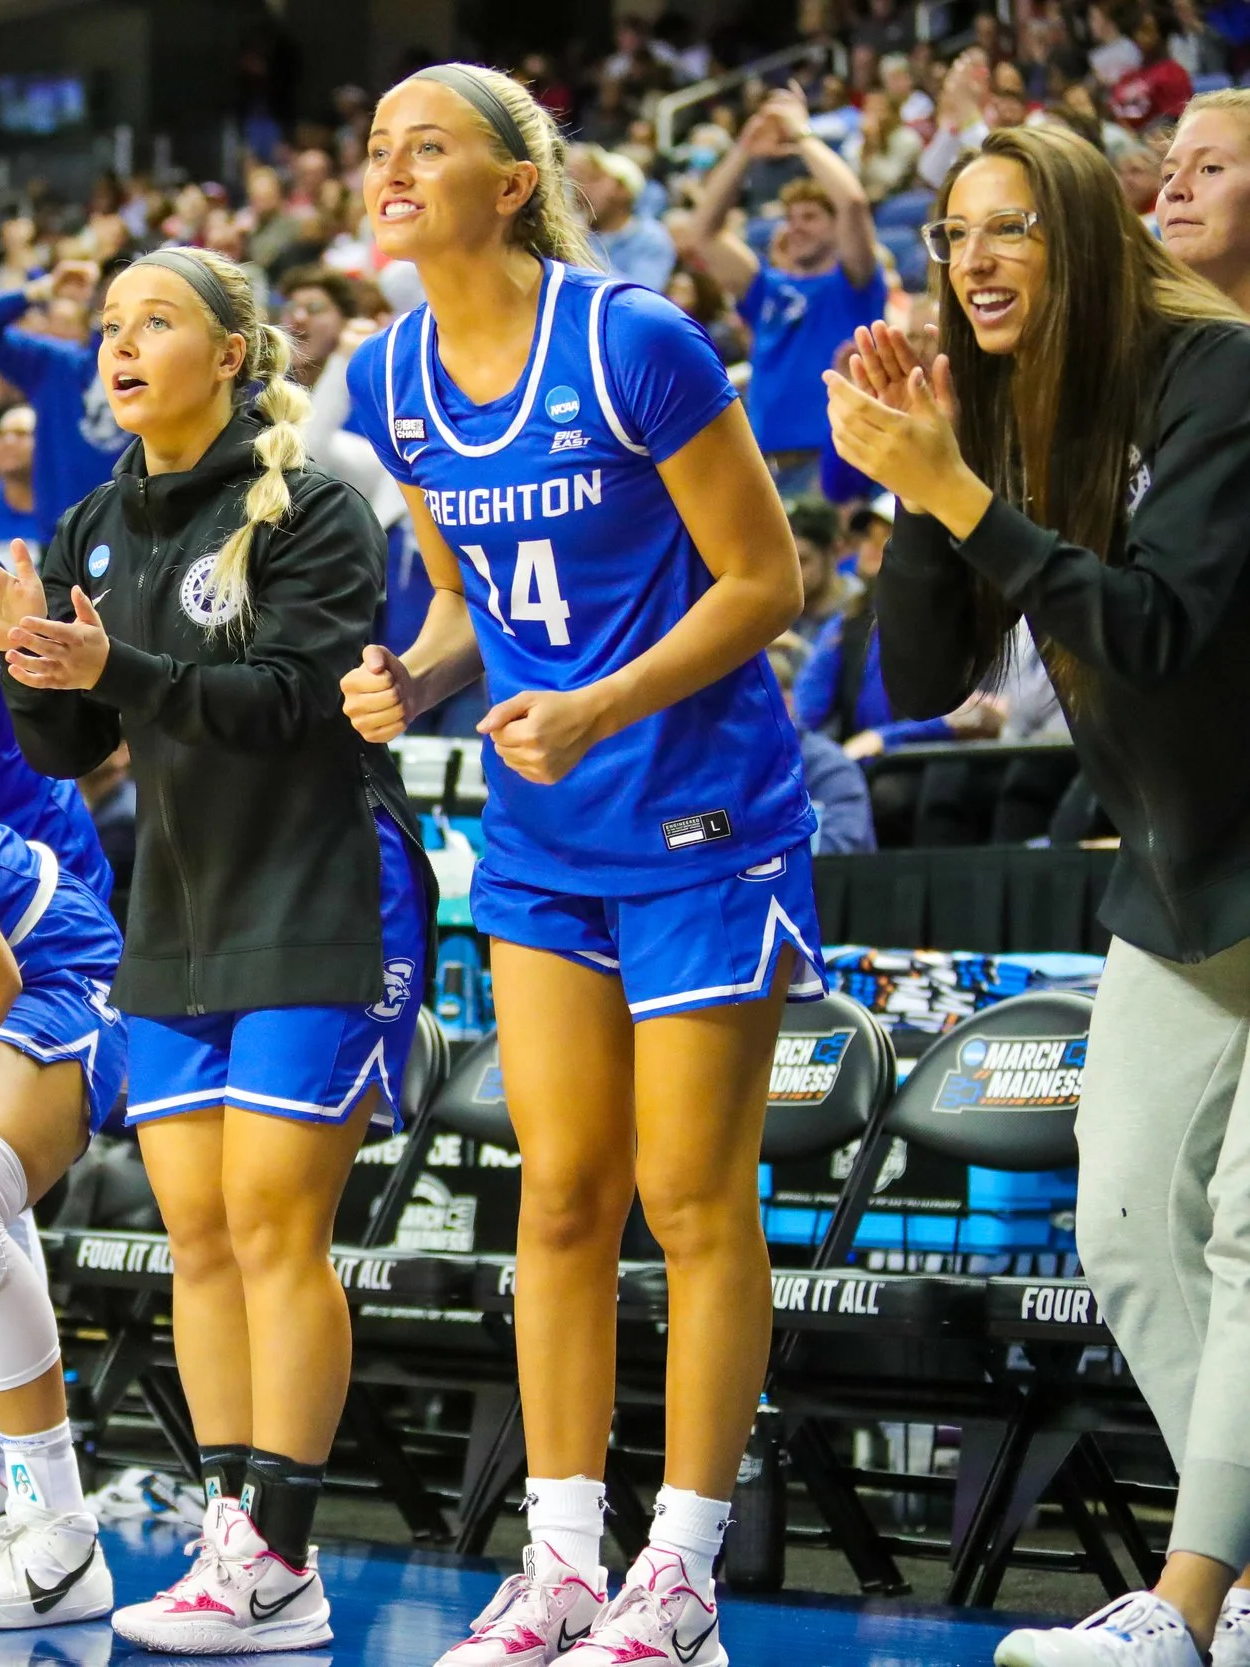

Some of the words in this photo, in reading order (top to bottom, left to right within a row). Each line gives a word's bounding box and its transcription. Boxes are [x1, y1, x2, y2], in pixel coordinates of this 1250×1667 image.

[550, 400, 579, 416] NCAA
[551, 437, 591, 449] EAST
[554, 430, 582, 441] BIG
[421, 469, 602, 526] REIGHTON
[710, 820, 721, 831] L
[773, 1038, 818, 1065] RCH
[982, 1041, 1067, 1069] MARCH
[769, 1065, 838, 1093] DNESS
[77, 1238, 128, 1271] FOUR
[127, 1242, 150, 1273] IT
[357, 1259, 392, 1290] ALL
[771, 1277, 809, 1311] UR
[811, 1279, 839, 1312] IT
[838, 1280, 880, 1314] ALL
[1021, 1287, 1091, 1324] FOUR
